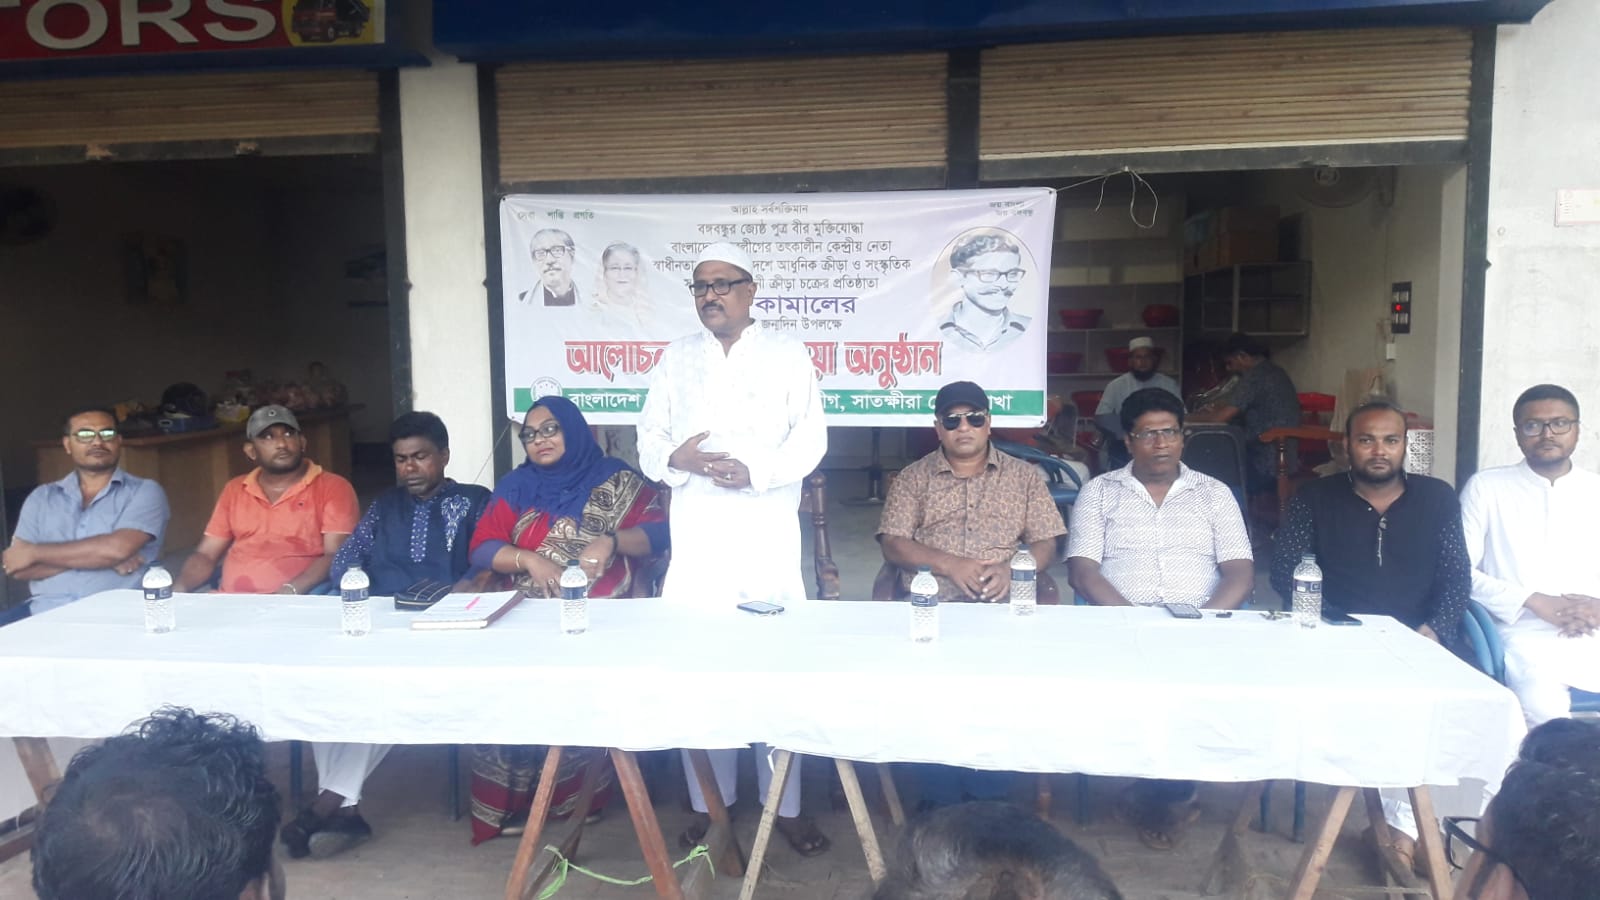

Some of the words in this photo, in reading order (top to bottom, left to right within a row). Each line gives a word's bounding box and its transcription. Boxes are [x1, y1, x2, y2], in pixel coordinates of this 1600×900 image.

[697, 222, 737, 238] বঙ্গবন্ধুর
[740, 219, 768, 236] জ্যেষ্ঠ
[771, 222, 789, 238] পুত্র
[791, 219, 810, 235] বীর
[813, 219, 865, 237] মুক্তিযোদ্ধা
[826, 236, 863, 254] কেন্দ্রীয়
[866, 240, 893, 253] নেতা
[776, 256, 818, 274] আধুনিক
[820, 255, 849, 274] ক্রীড়া
[852, 259, 862, 271] ও
[768, 274, 797, 293] ক্রীড়া
[799, 278, 830, 290] চক্রের
[832, 272, 880, 290] প্রতিষ্ঠাতা
[753, 295, 859, 315] কামালের
[761, 316, 798, 331] জন্মদিন
[800, 315, 844, 331] উপলক্ষে
[844, 332, 944, 390] অনুষ্ঠান
[567, 391, 643, 410] বাংলাদেশ
[850, 390, 923, 411] সাতক্ষীরা
